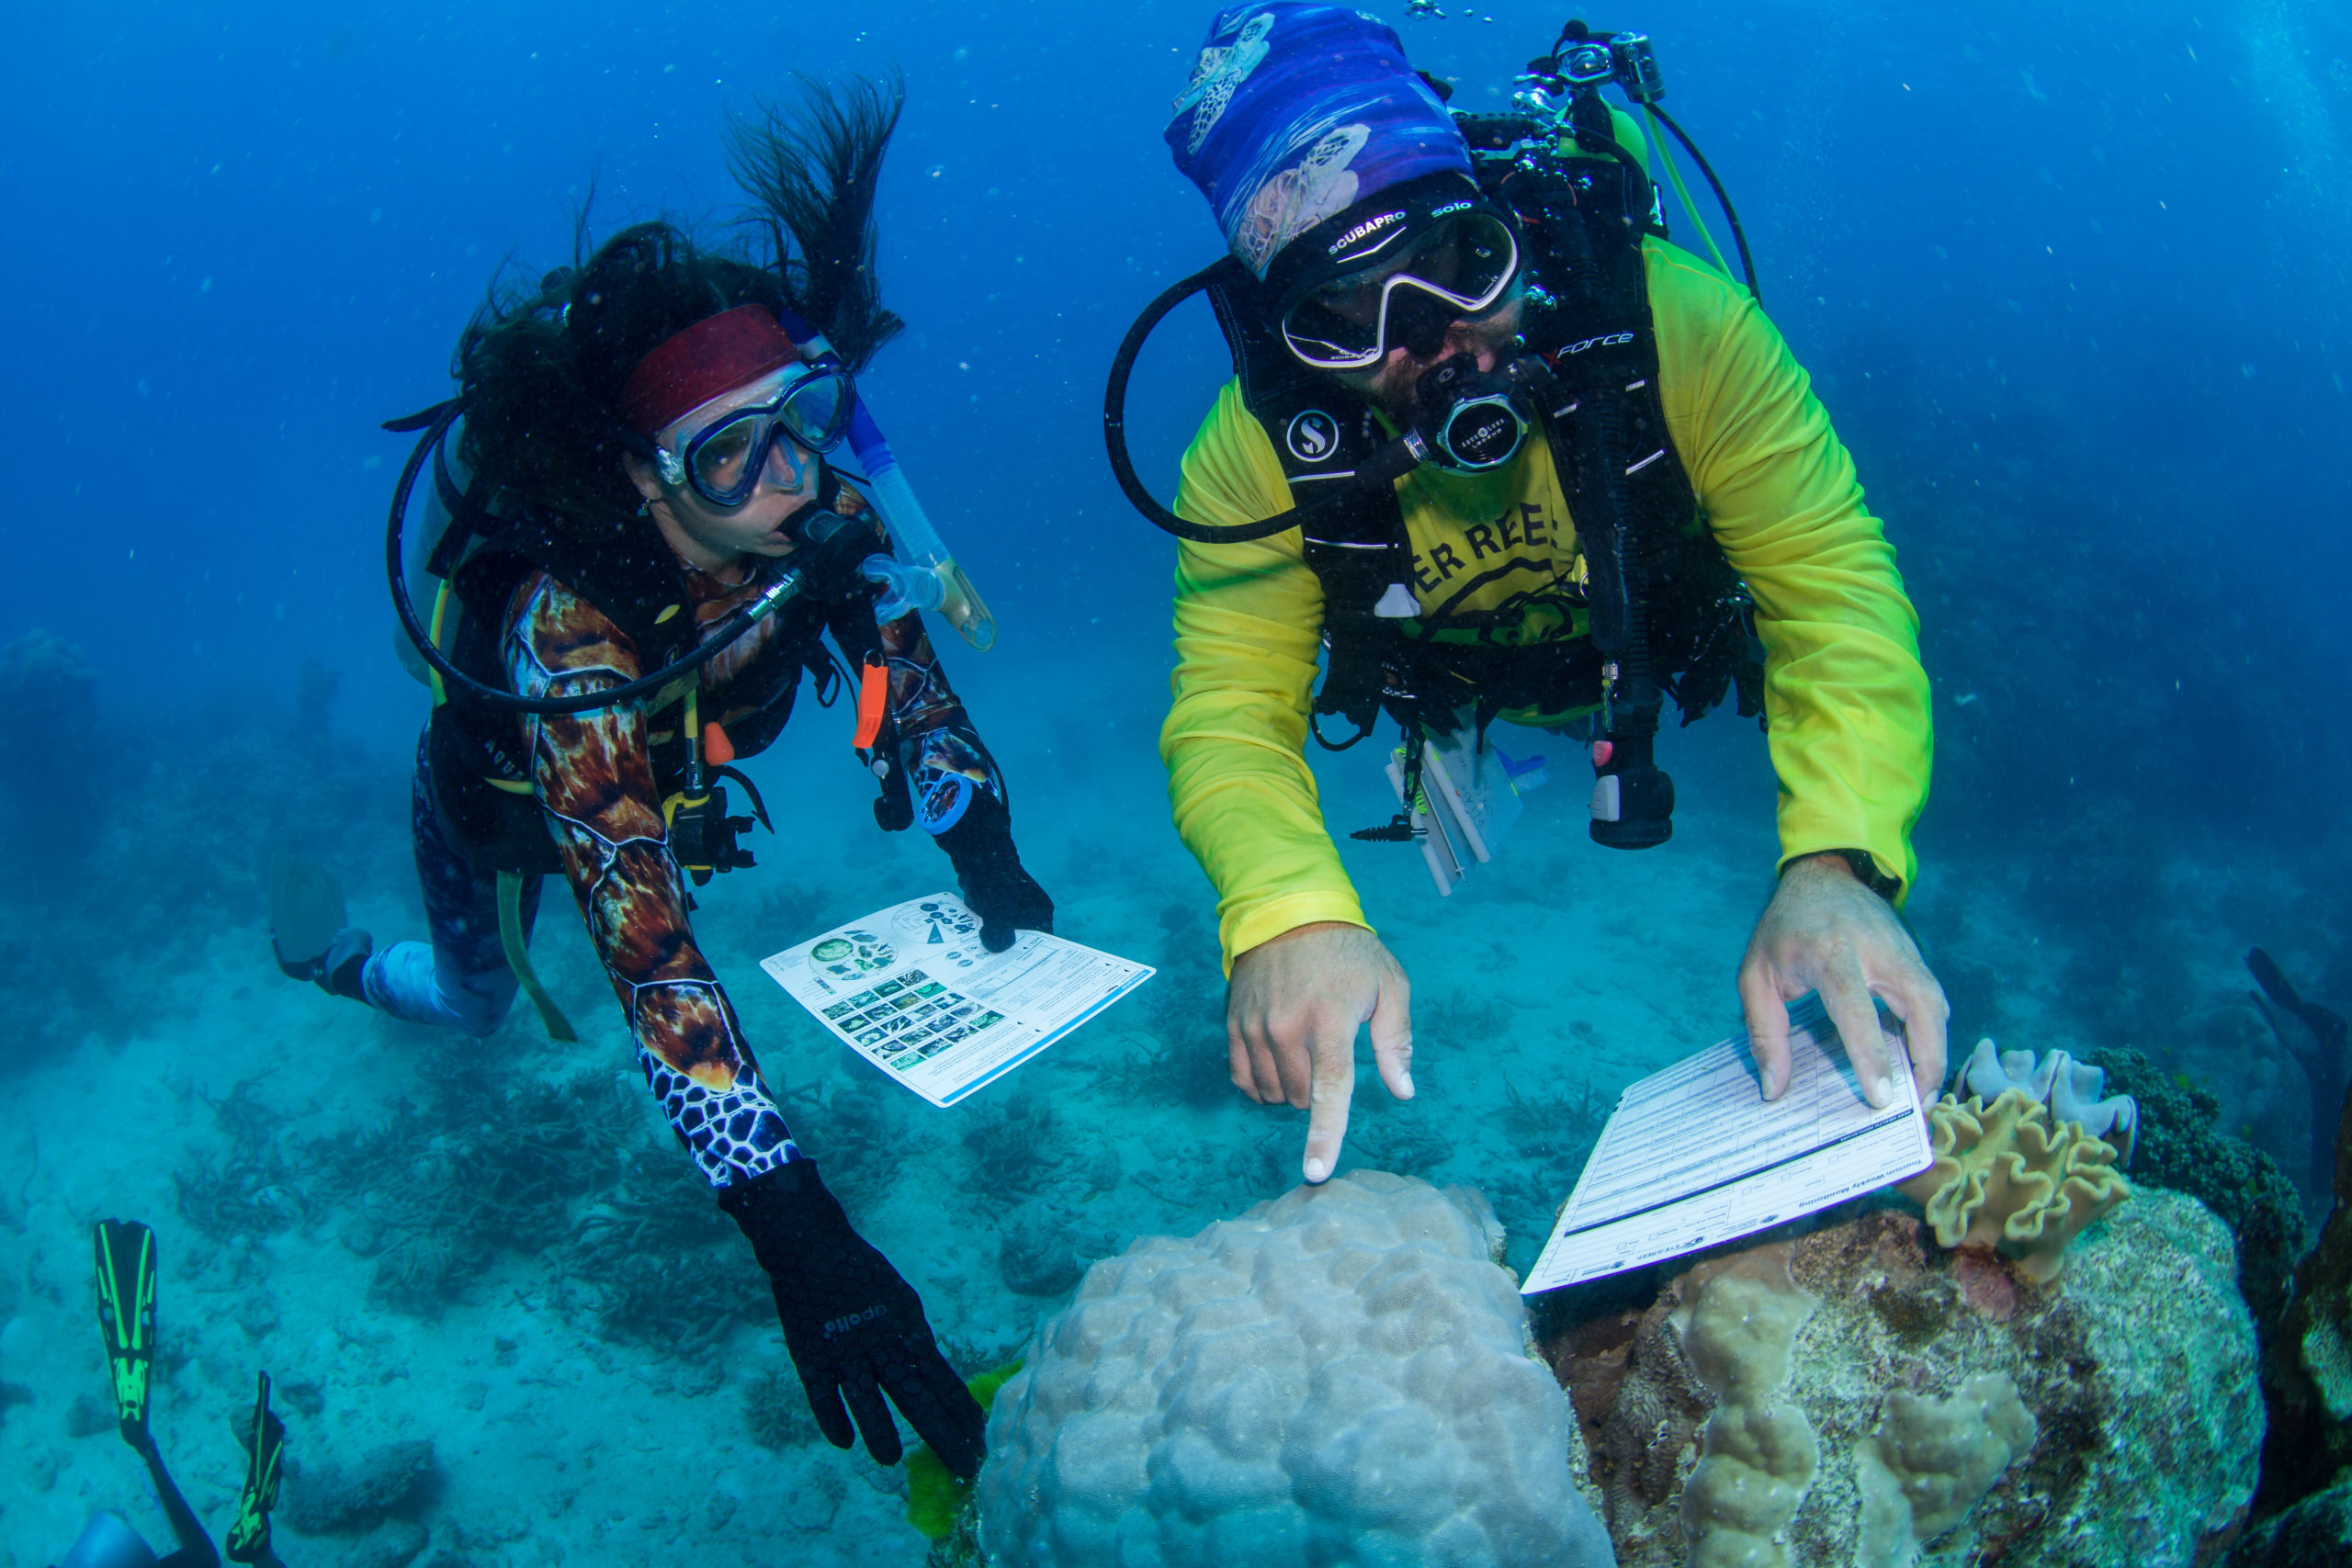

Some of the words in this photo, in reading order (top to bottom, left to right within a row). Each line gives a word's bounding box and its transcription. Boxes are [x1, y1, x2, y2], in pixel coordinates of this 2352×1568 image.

[1430, 199, 1474, 219] solo
[1328, 209, 1407, 255] SCUBAPRO
[1886, 1159, 1923, 1177] Tourism
[1851, 1173, 1885, 1190] Weekly
[1799, 1186, 1850, 1208] Monitoring
